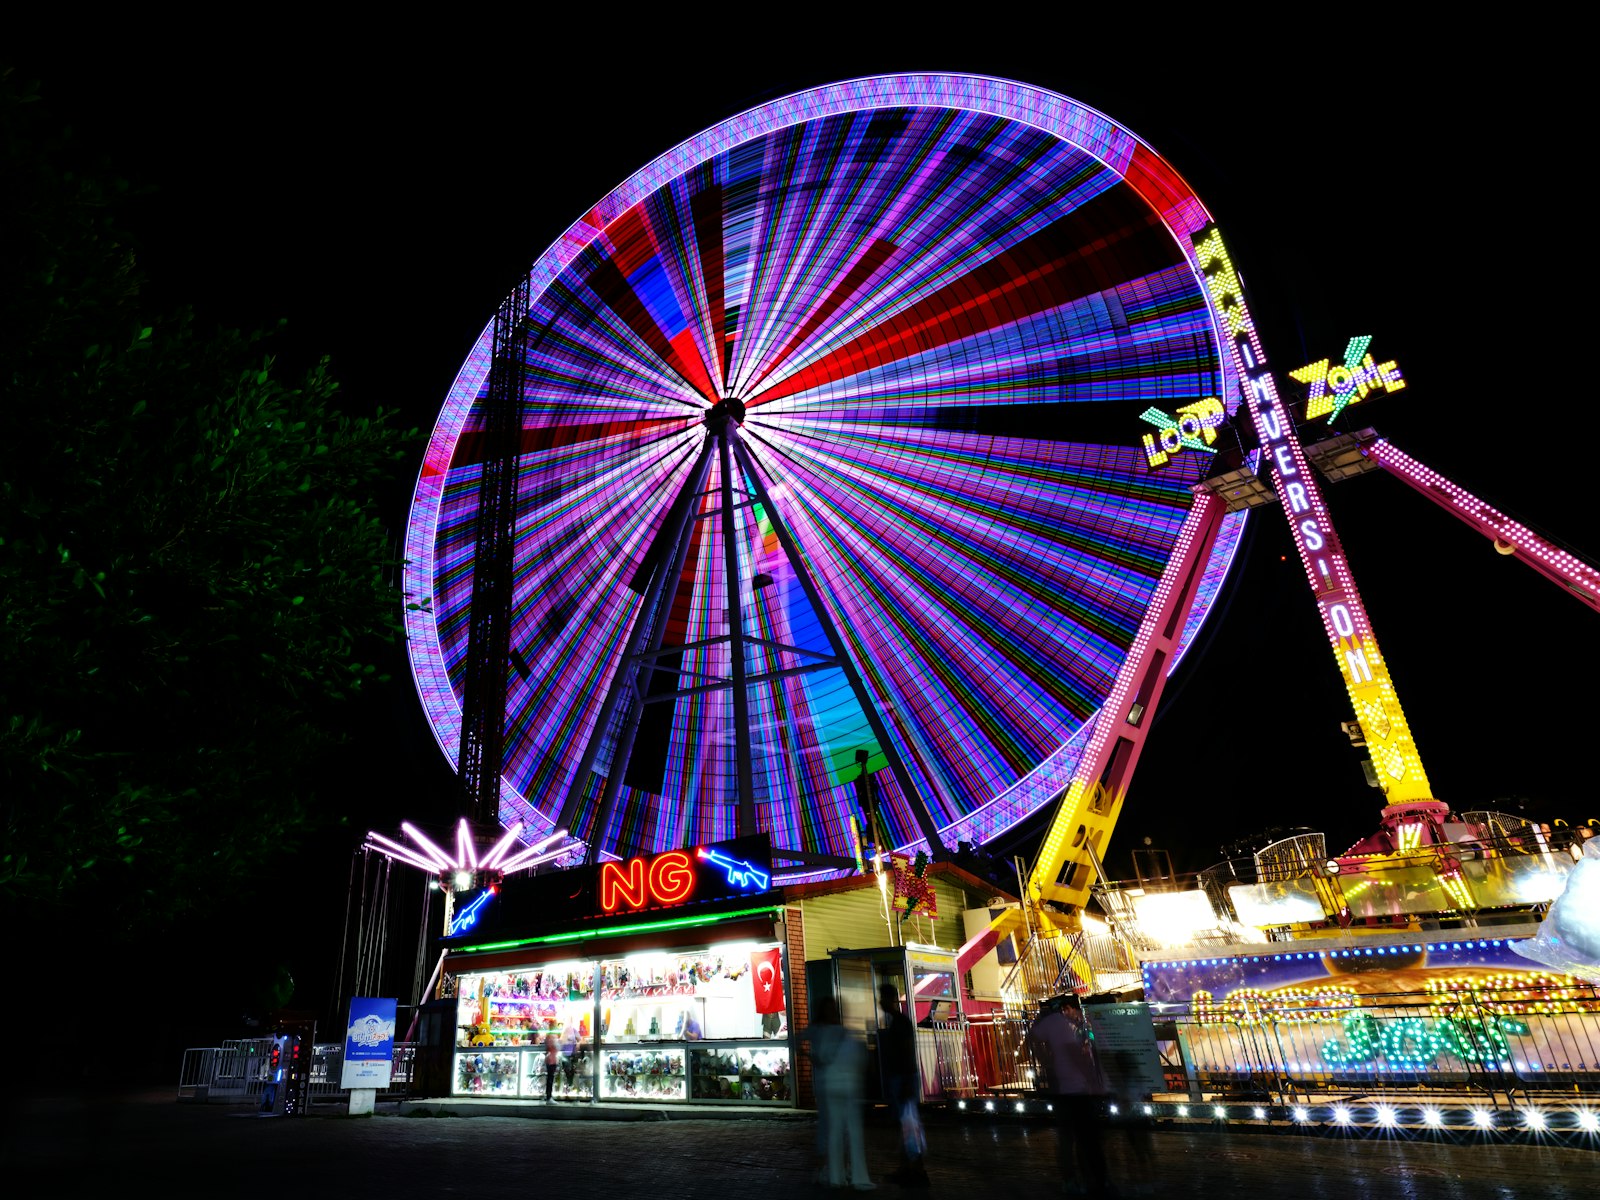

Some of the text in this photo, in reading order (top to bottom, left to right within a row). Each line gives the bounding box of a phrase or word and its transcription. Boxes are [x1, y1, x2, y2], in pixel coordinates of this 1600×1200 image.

[1141, 353, 1407, 469] LOOP ZONE
[1242, 342, 1374, 684] INVERSION
[603, 853, 693, 910] NG
